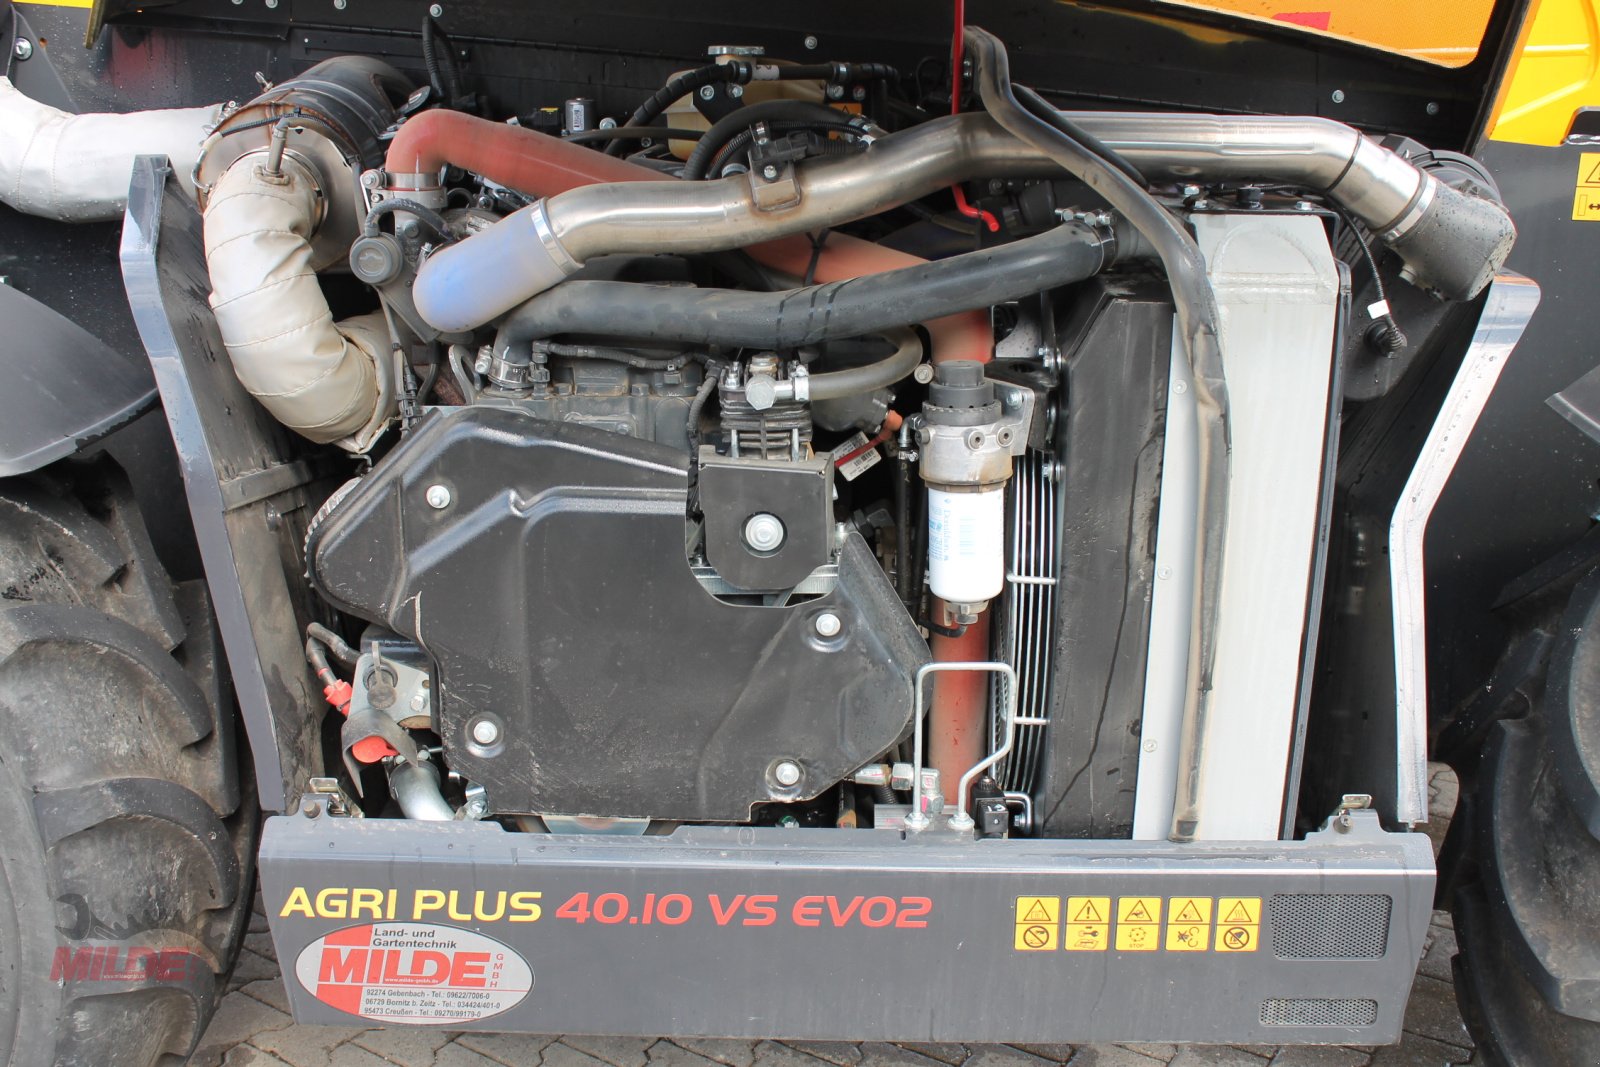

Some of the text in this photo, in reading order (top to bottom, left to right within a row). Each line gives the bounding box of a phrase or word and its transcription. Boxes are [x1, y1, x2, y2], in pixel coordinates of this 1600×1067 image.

[280, 887, 932, 928] AGRI PLUS 40.10 VS EVO2
[374, 928, 435, 938] Land- und
[373, 938, 457, 949] Gartentechnik
[318, 948, 491, 987] MILDE
[387, 990, 426, 998] Gebenbach
[446, 991, 490, 999] 09622/7006-0
[386, 999, 411, 1007] Bornitz
